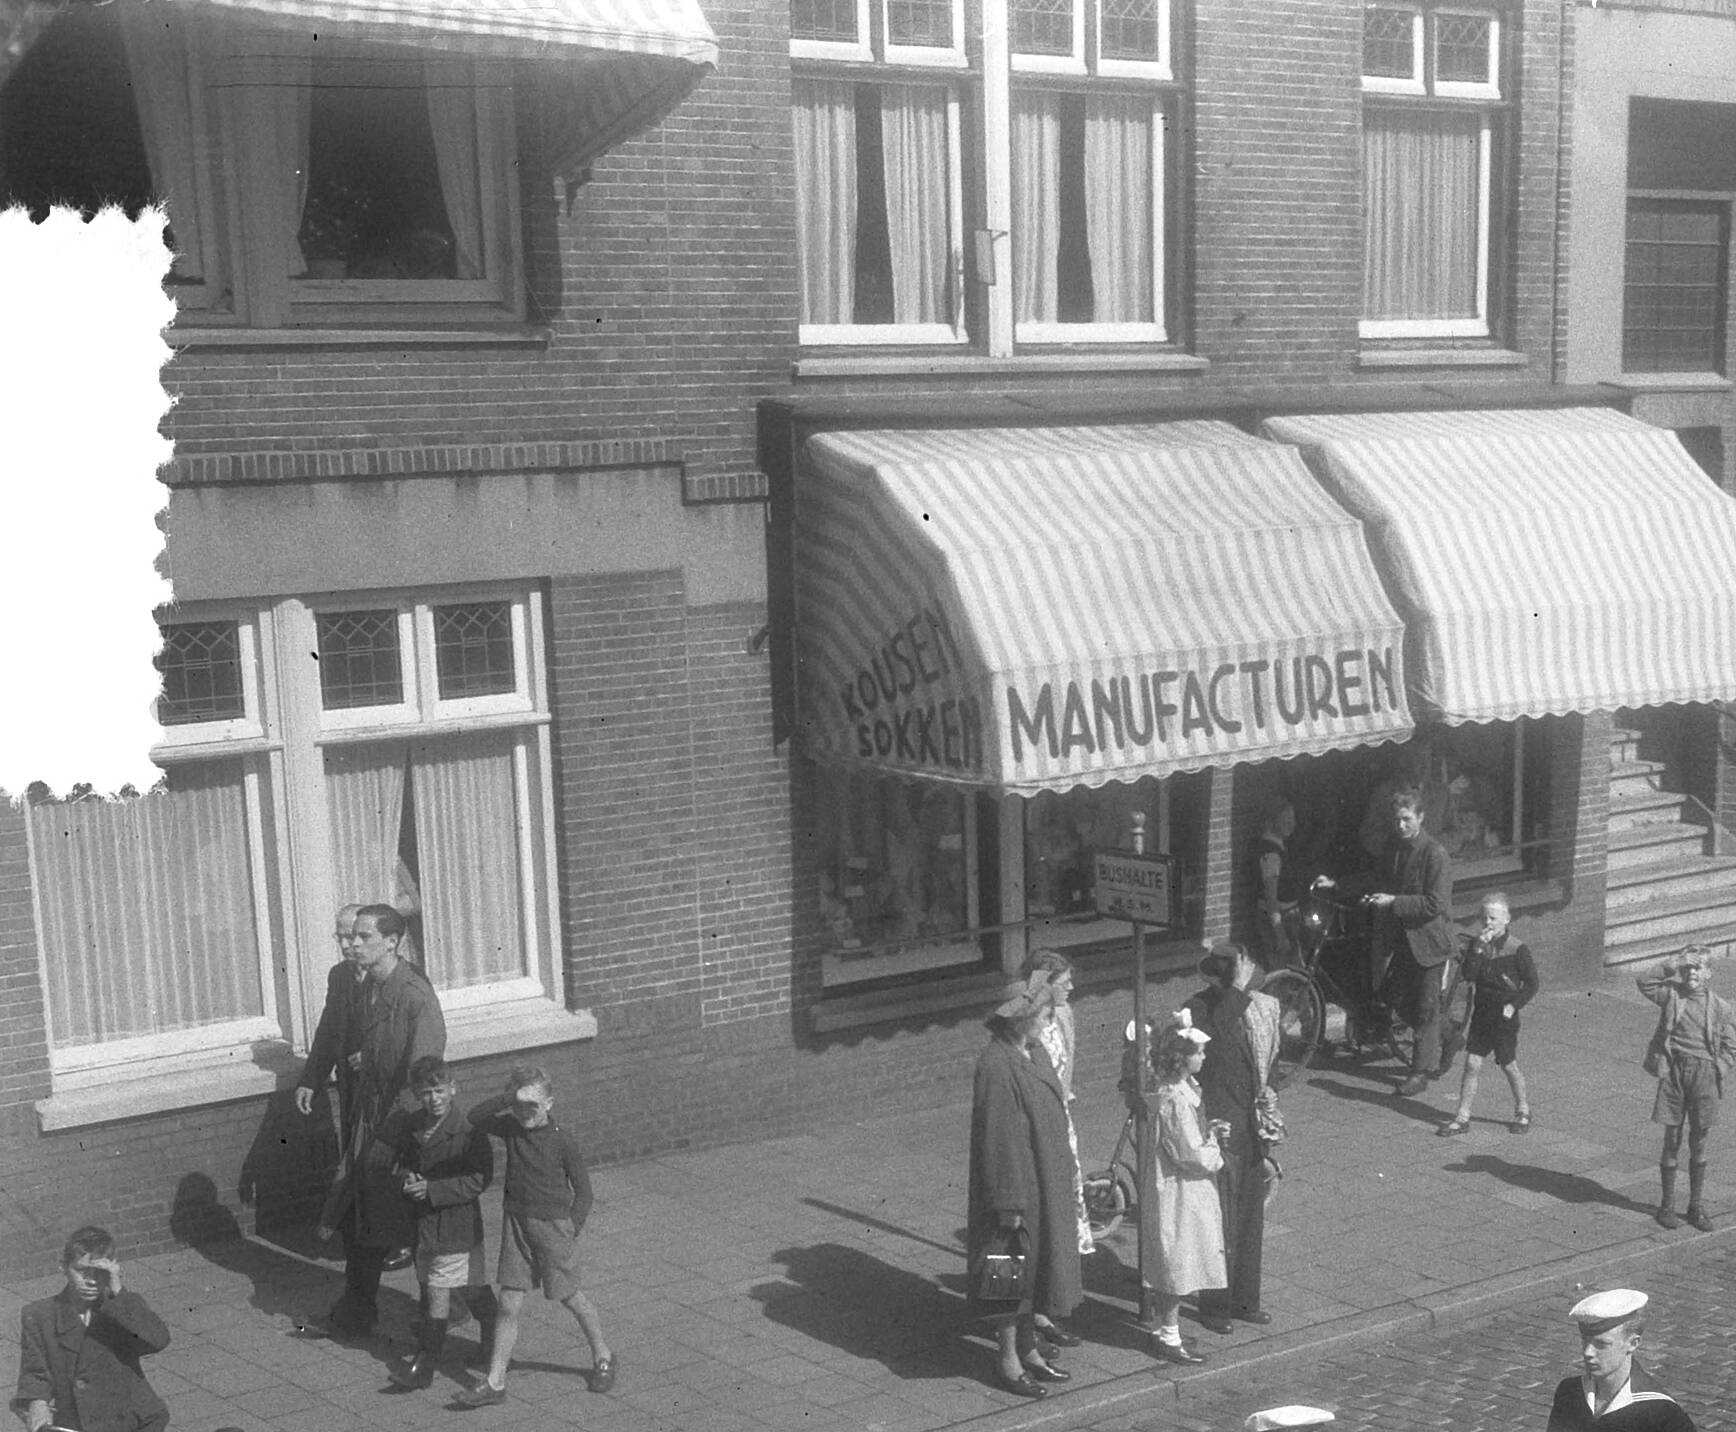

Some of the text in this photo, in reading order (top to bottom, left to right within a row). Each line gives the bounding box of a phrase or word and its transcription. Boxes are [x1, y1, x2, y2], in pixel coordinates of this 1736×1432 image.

[840, 600, 962, 722] KOUSEN
[1008, 646, 1398, 762] MANUFACTUREN
[857, 696, 983, 774] SOKKEN
[1098, 863, 1164, 890] BUSHALTE
